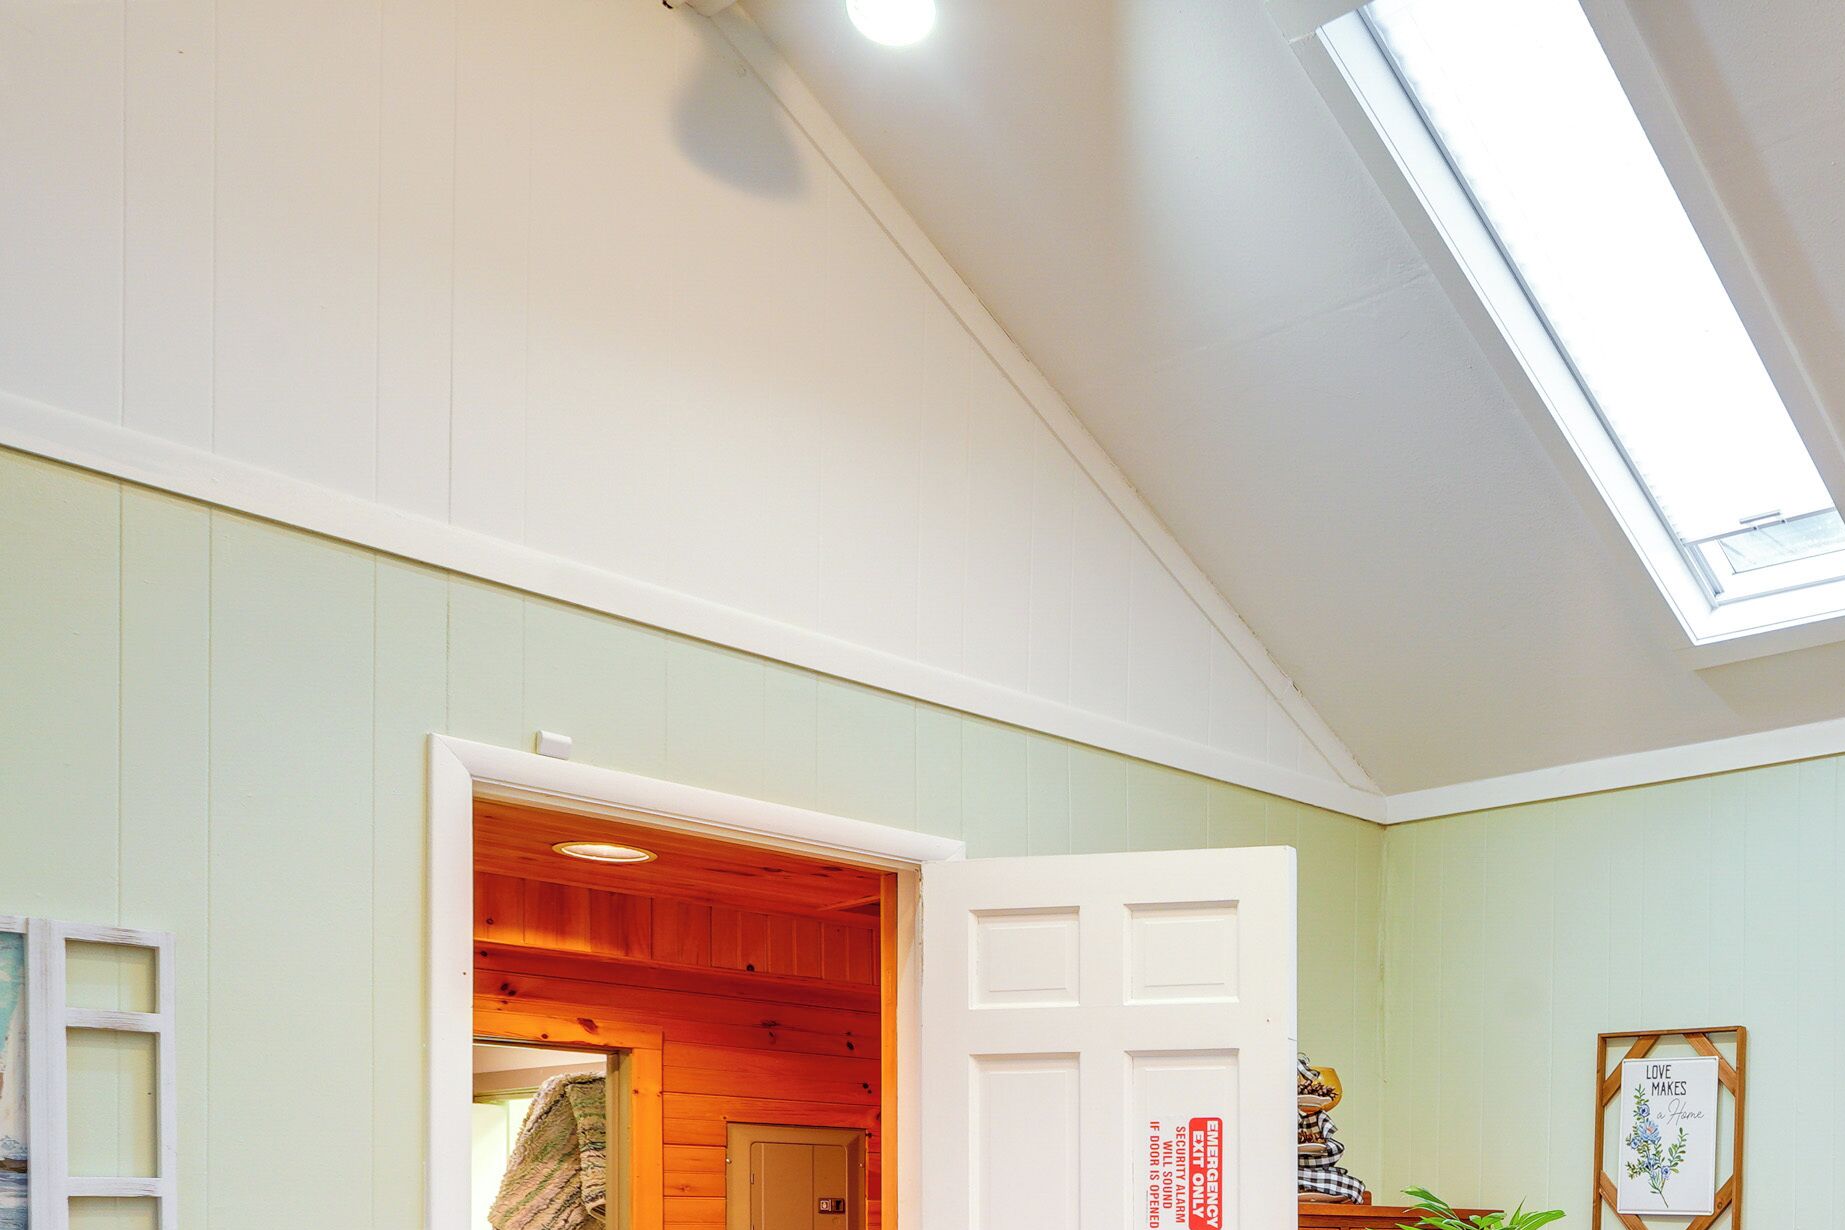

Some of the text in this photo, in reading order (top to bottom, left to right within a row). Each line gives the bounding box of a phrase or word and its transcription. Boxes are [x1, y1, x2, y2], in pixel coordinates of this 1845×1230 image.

[1646, 1064, 1672, 1080] LOVE
[1651, 1081, 1687, 1096] MAKES
[1656, 1097, 1705, 1127] a Home
[1149, 1121, 1160, 1229] IF DOOR IS OPENED
[1162, 1140, 1173, 1209] WILL SOUND
[1175, 1126, 1186, 1223] SECURITY ALARM
[1192, 1130, 1205, 1219] EXIT ONLY
[1206, 1120, 1219, 1229] EMERGENCY
